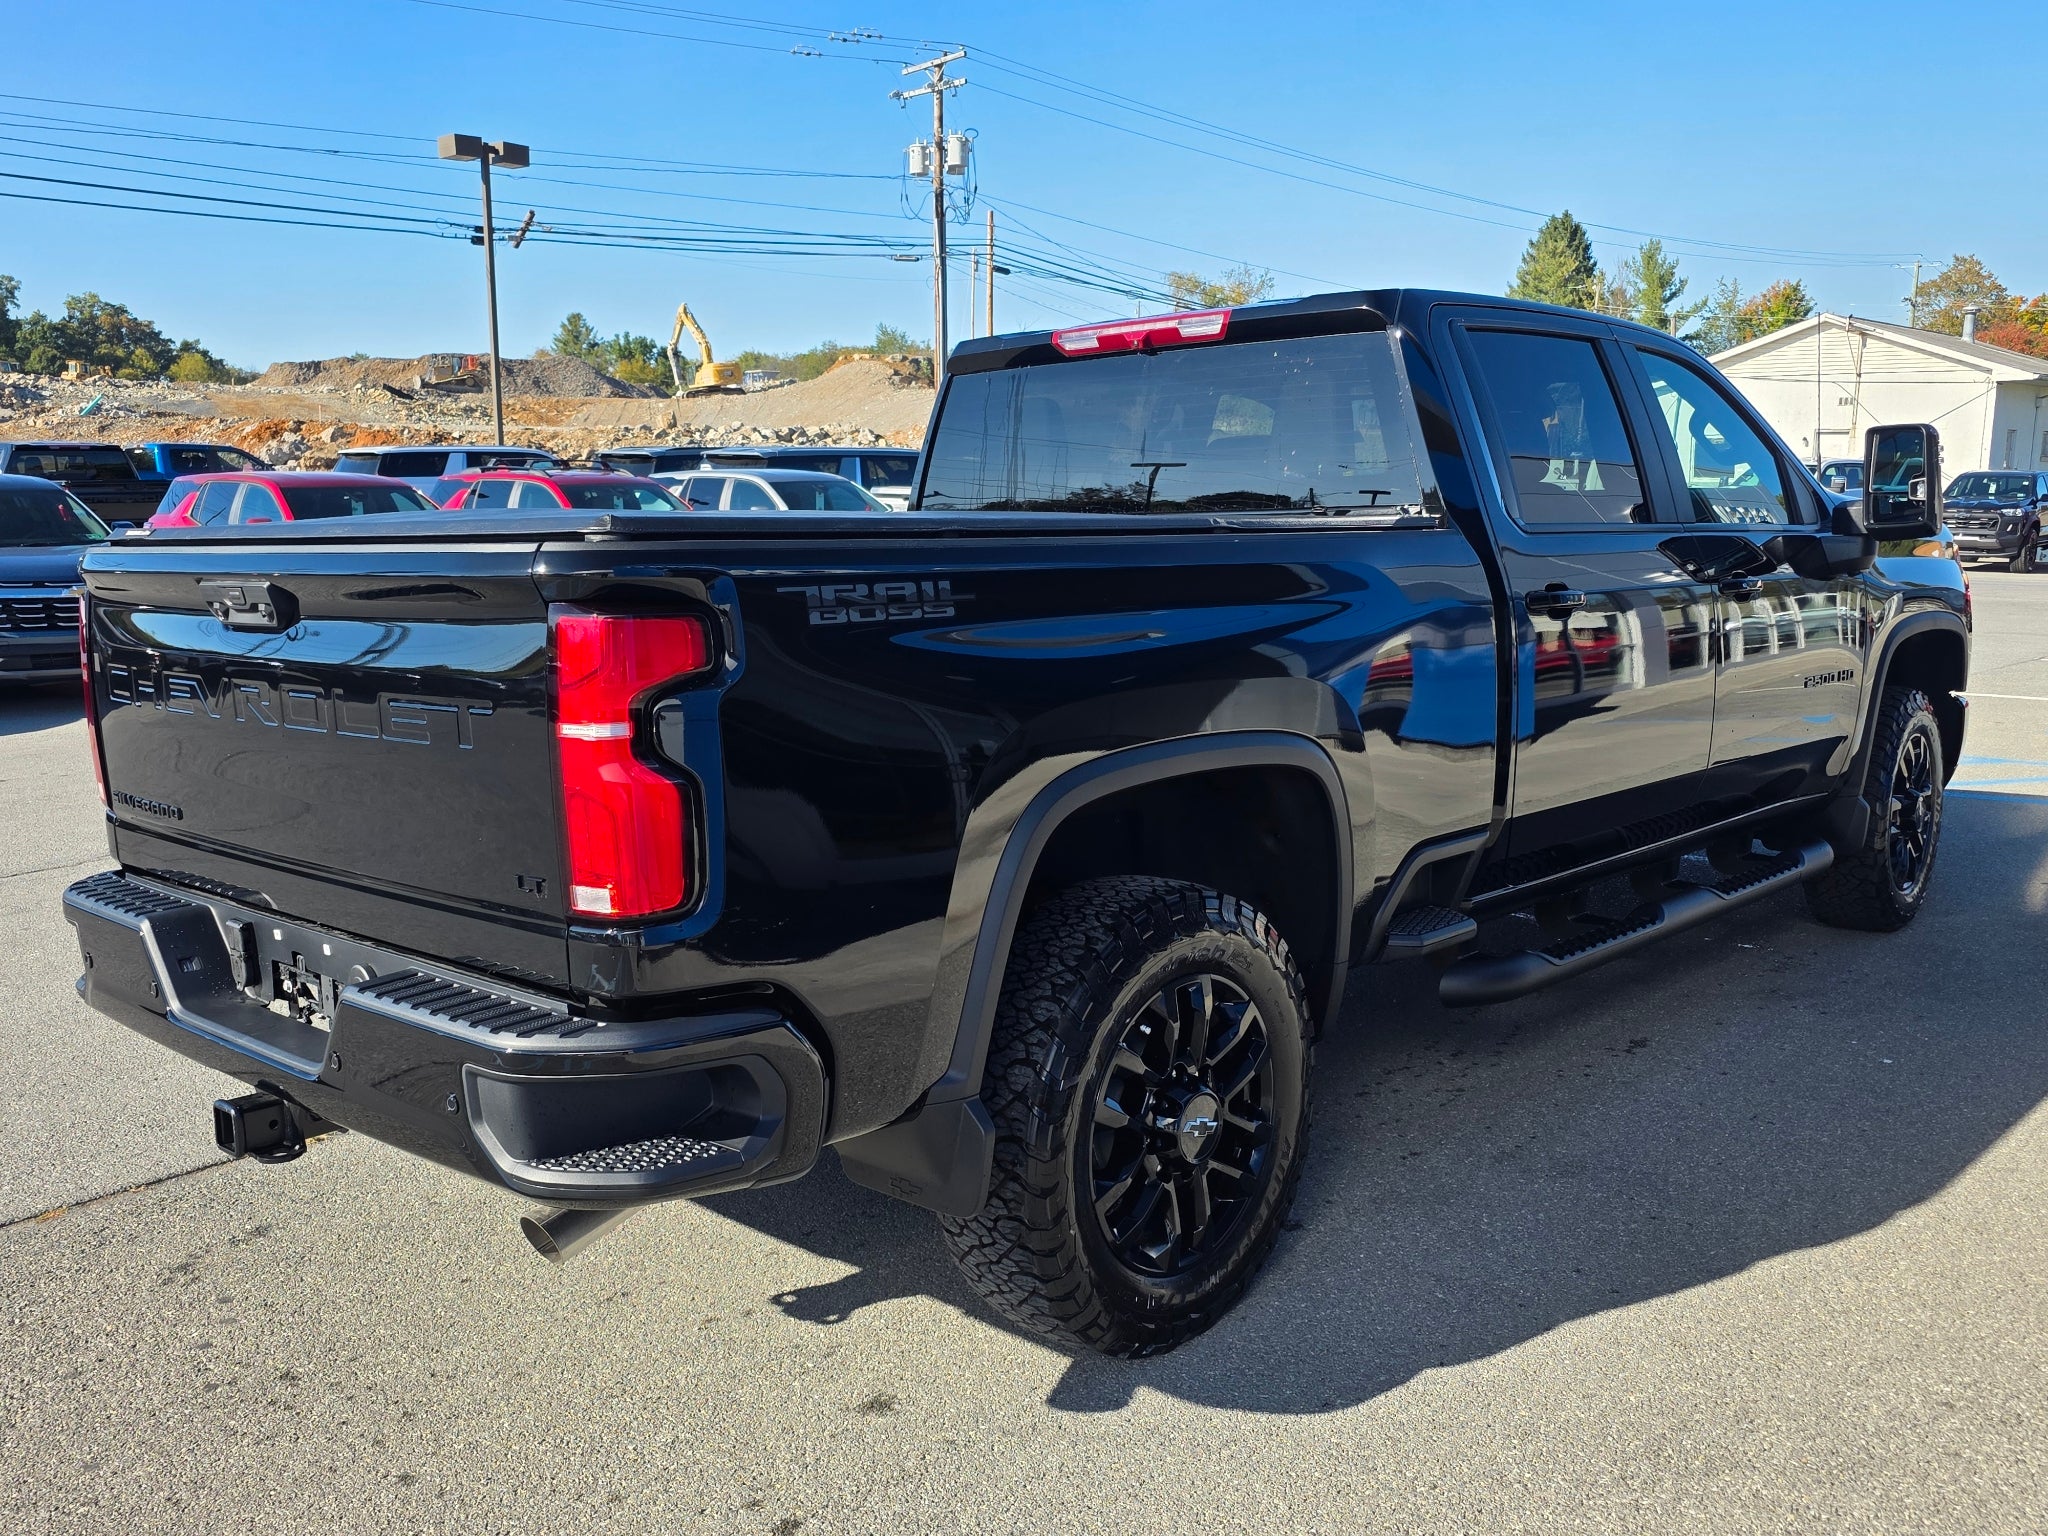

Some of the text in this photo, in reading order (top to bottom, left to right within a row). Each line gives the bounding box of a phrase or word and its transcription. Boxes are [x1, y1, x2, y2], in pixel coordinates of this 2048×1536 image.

[776, 580, 977, 607] TRAIL
[808, 601, 956, 625] BOSS
[1803, 668, 1855, 689] 2500 HD
[107, 663, 493, 750] CHEVROLET
[112, 789, 184, 820] SILVERADO
[513, 873, 547, 897] LT
